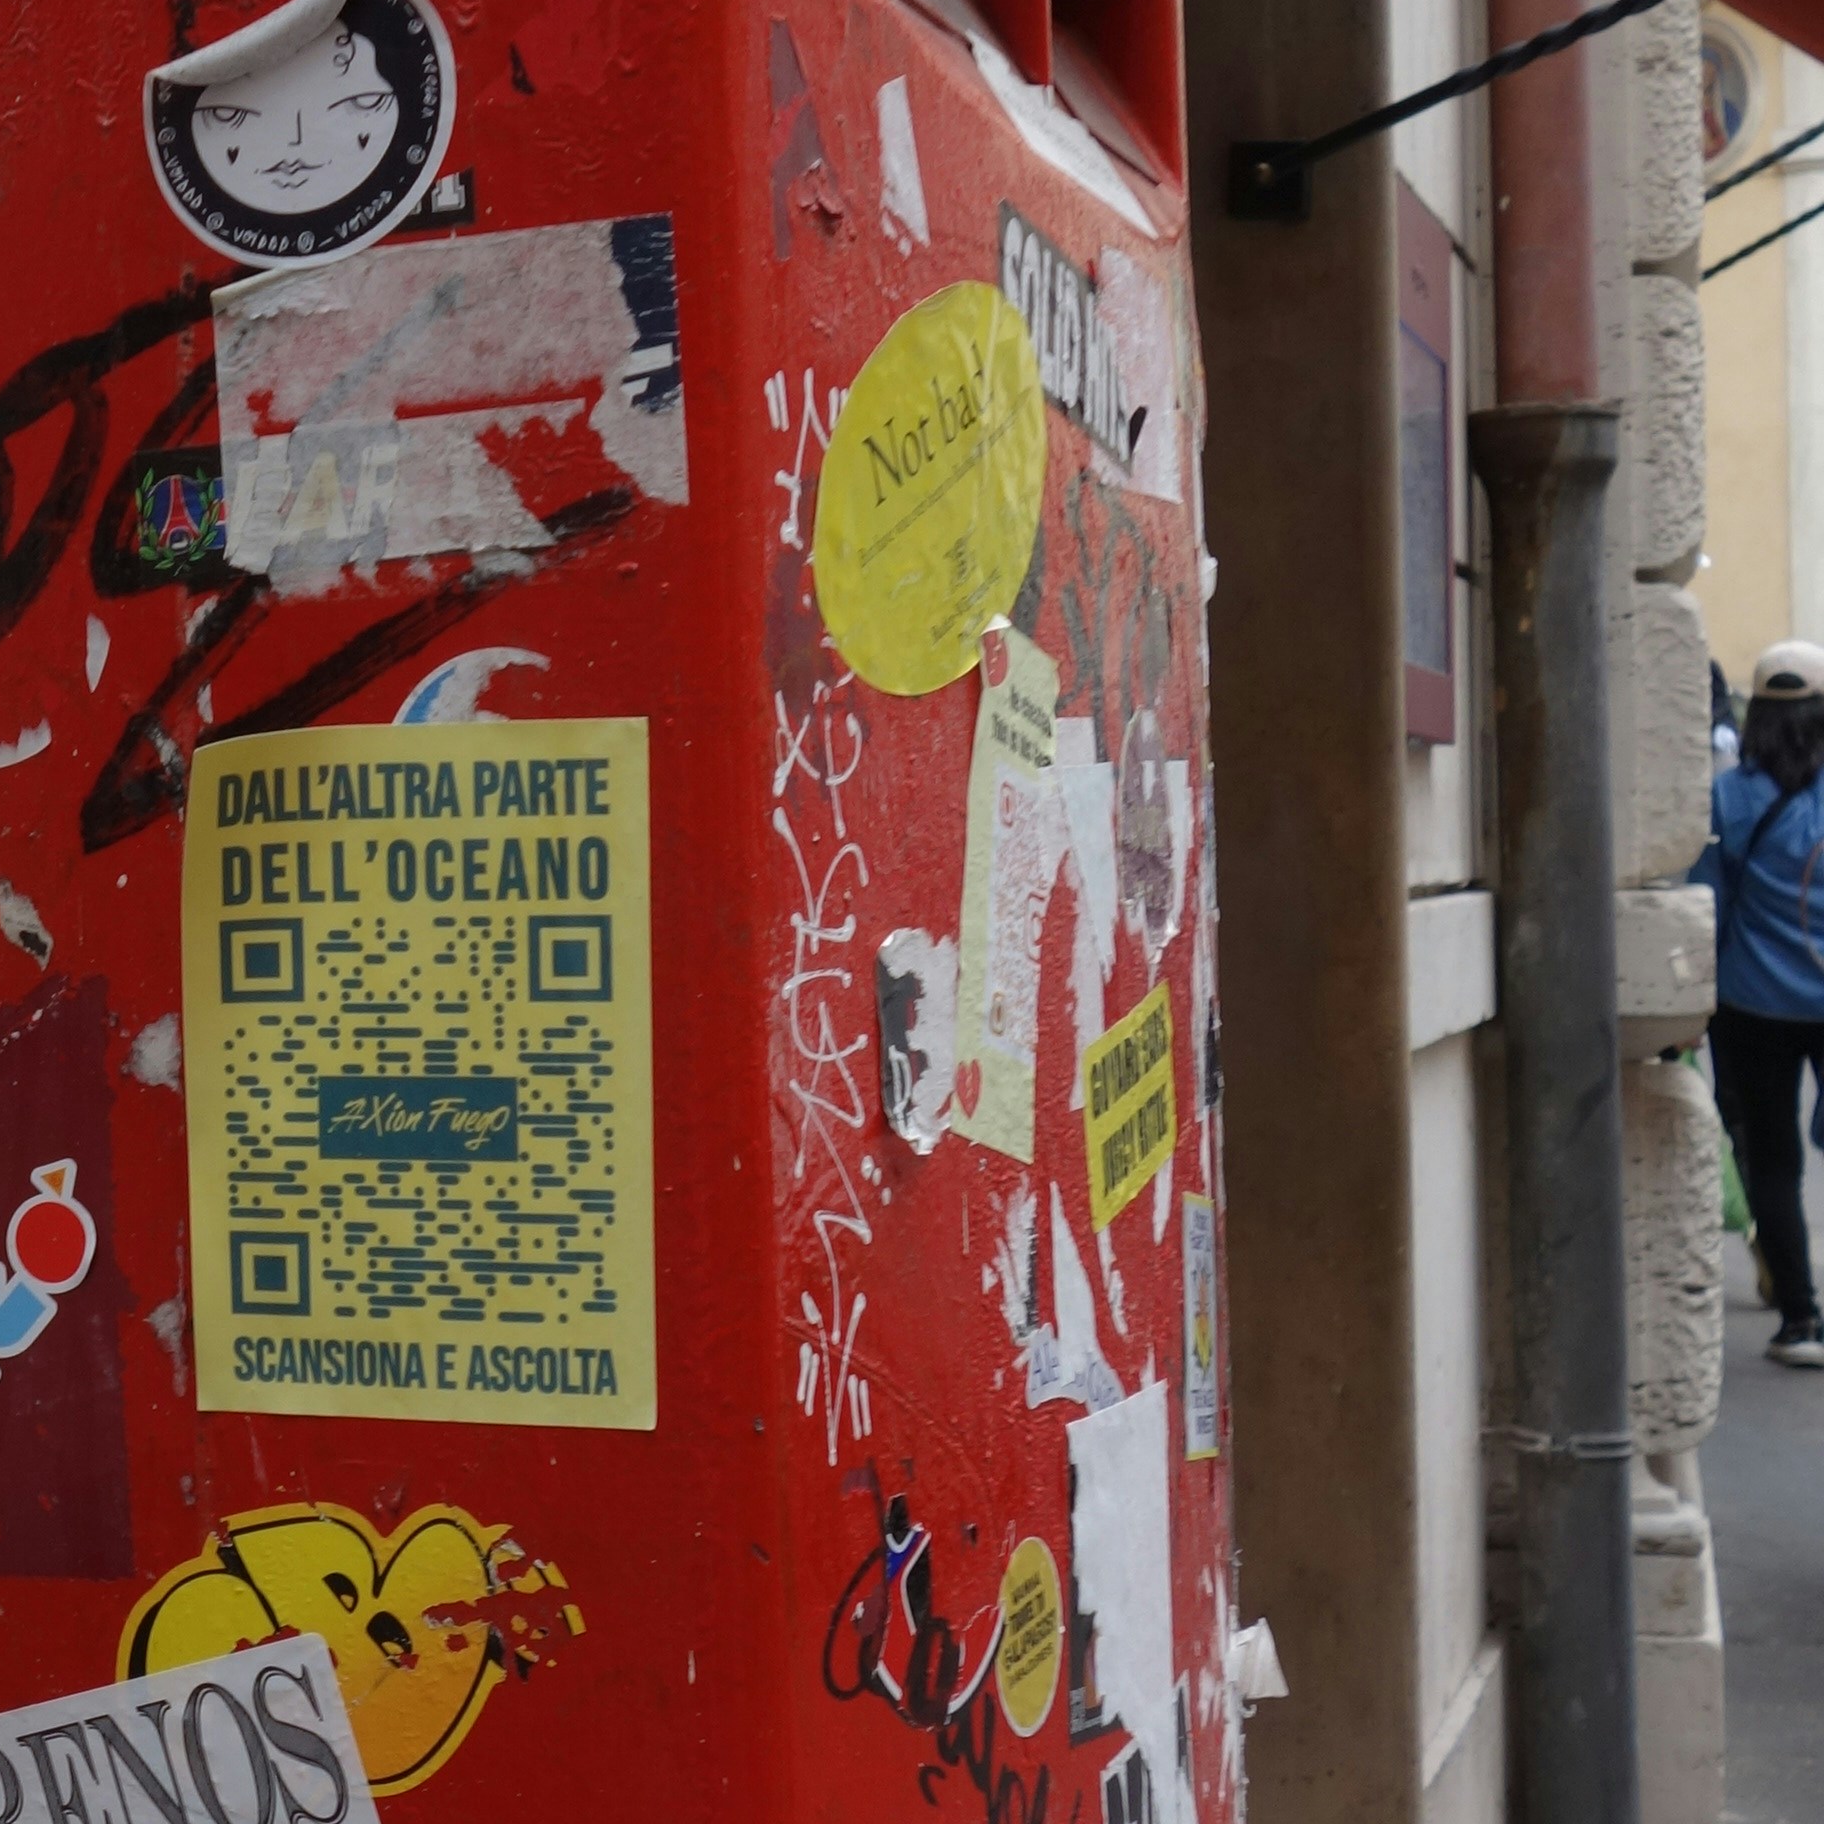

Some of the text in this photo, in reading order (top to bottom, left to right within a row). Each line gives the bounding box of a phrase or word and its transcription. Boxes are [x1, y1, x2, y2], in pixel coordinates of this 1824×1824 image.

[861, 416, 937, 510] Not
[217, 757, 610, 828] DALL'ALTRA PARTE
[221, 835, 610, 907] DELL'OCEANO
[426, 1096, 510, 1150] Fuego
[233, 1336, 619, 1397] SCANSIONA E ASCOLTA
